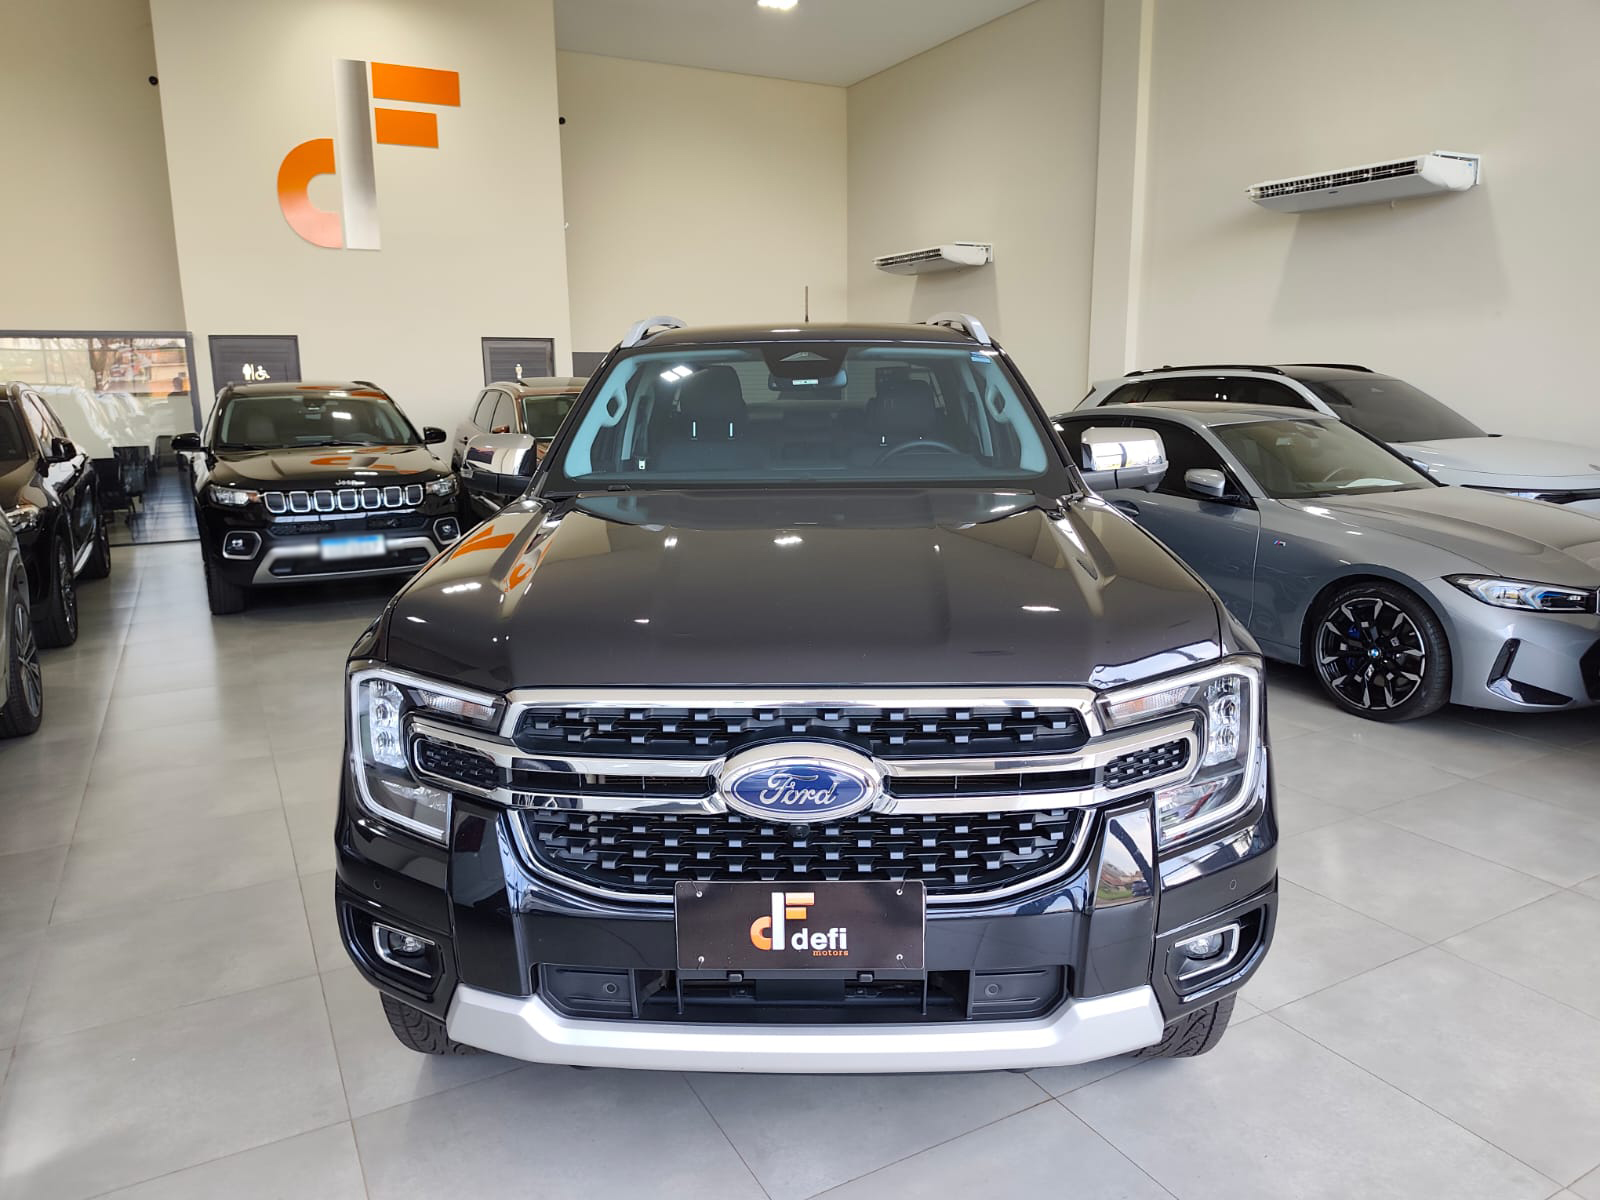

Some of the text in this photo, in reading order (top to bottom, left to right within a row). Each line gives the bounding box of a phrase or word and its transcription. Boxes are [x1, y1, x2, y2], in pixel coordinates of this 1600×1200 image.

[760, 773, 836, 805] Ford
[791, 927, 847, 951] defi
[812, 949, 849, 957] motors
